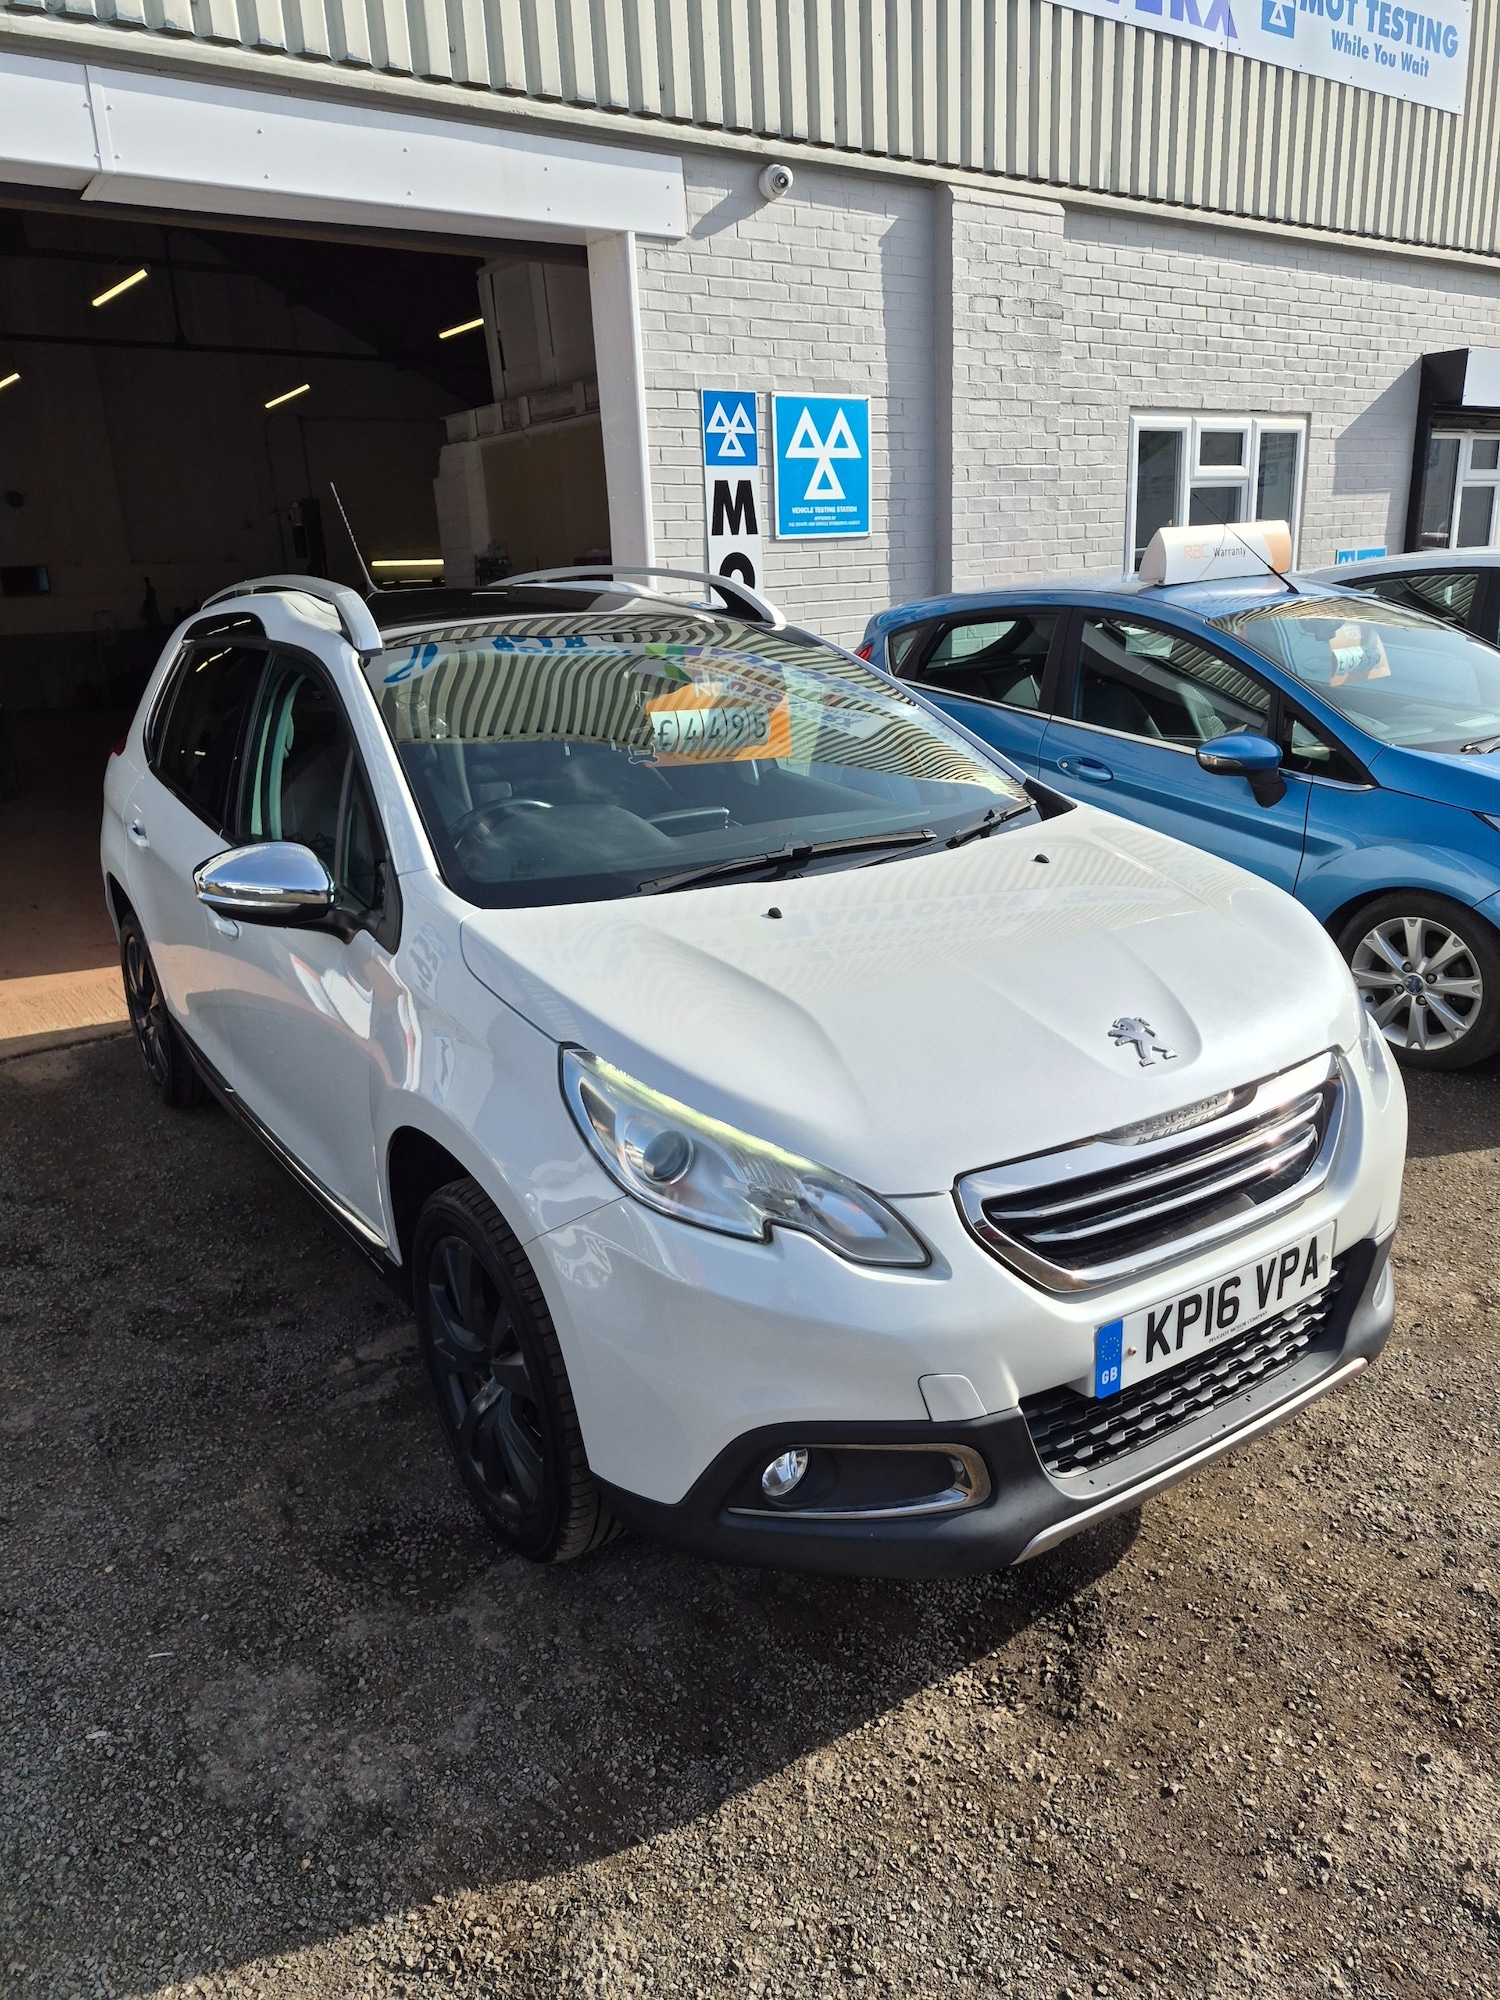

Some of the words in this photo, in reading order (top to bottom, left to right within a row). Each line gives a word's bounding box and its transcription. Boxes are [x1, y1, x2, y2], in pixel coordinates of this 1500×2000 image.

[1366, 0, 1458, 58] TESTING
[1332, 29, 1369, 59] While
[1373, 43, 1396, 68] You
[1401, 52, 1430, 77] Wait
[791, 506, 814, 514] VEHICLE
[1213, 547, 1247, 557] Warranty
[657, 707, 767, 747] £4495
[1145, 1275, 1242, 1364] KP16
[1255, 1236, 1319, 1310] VPA
[1208, 1330, 1230, 1344] PEUGEOT
[1247, 1310, 1268, 1325] COMPANY
[1101, 1366, 1118, 1385] GB
